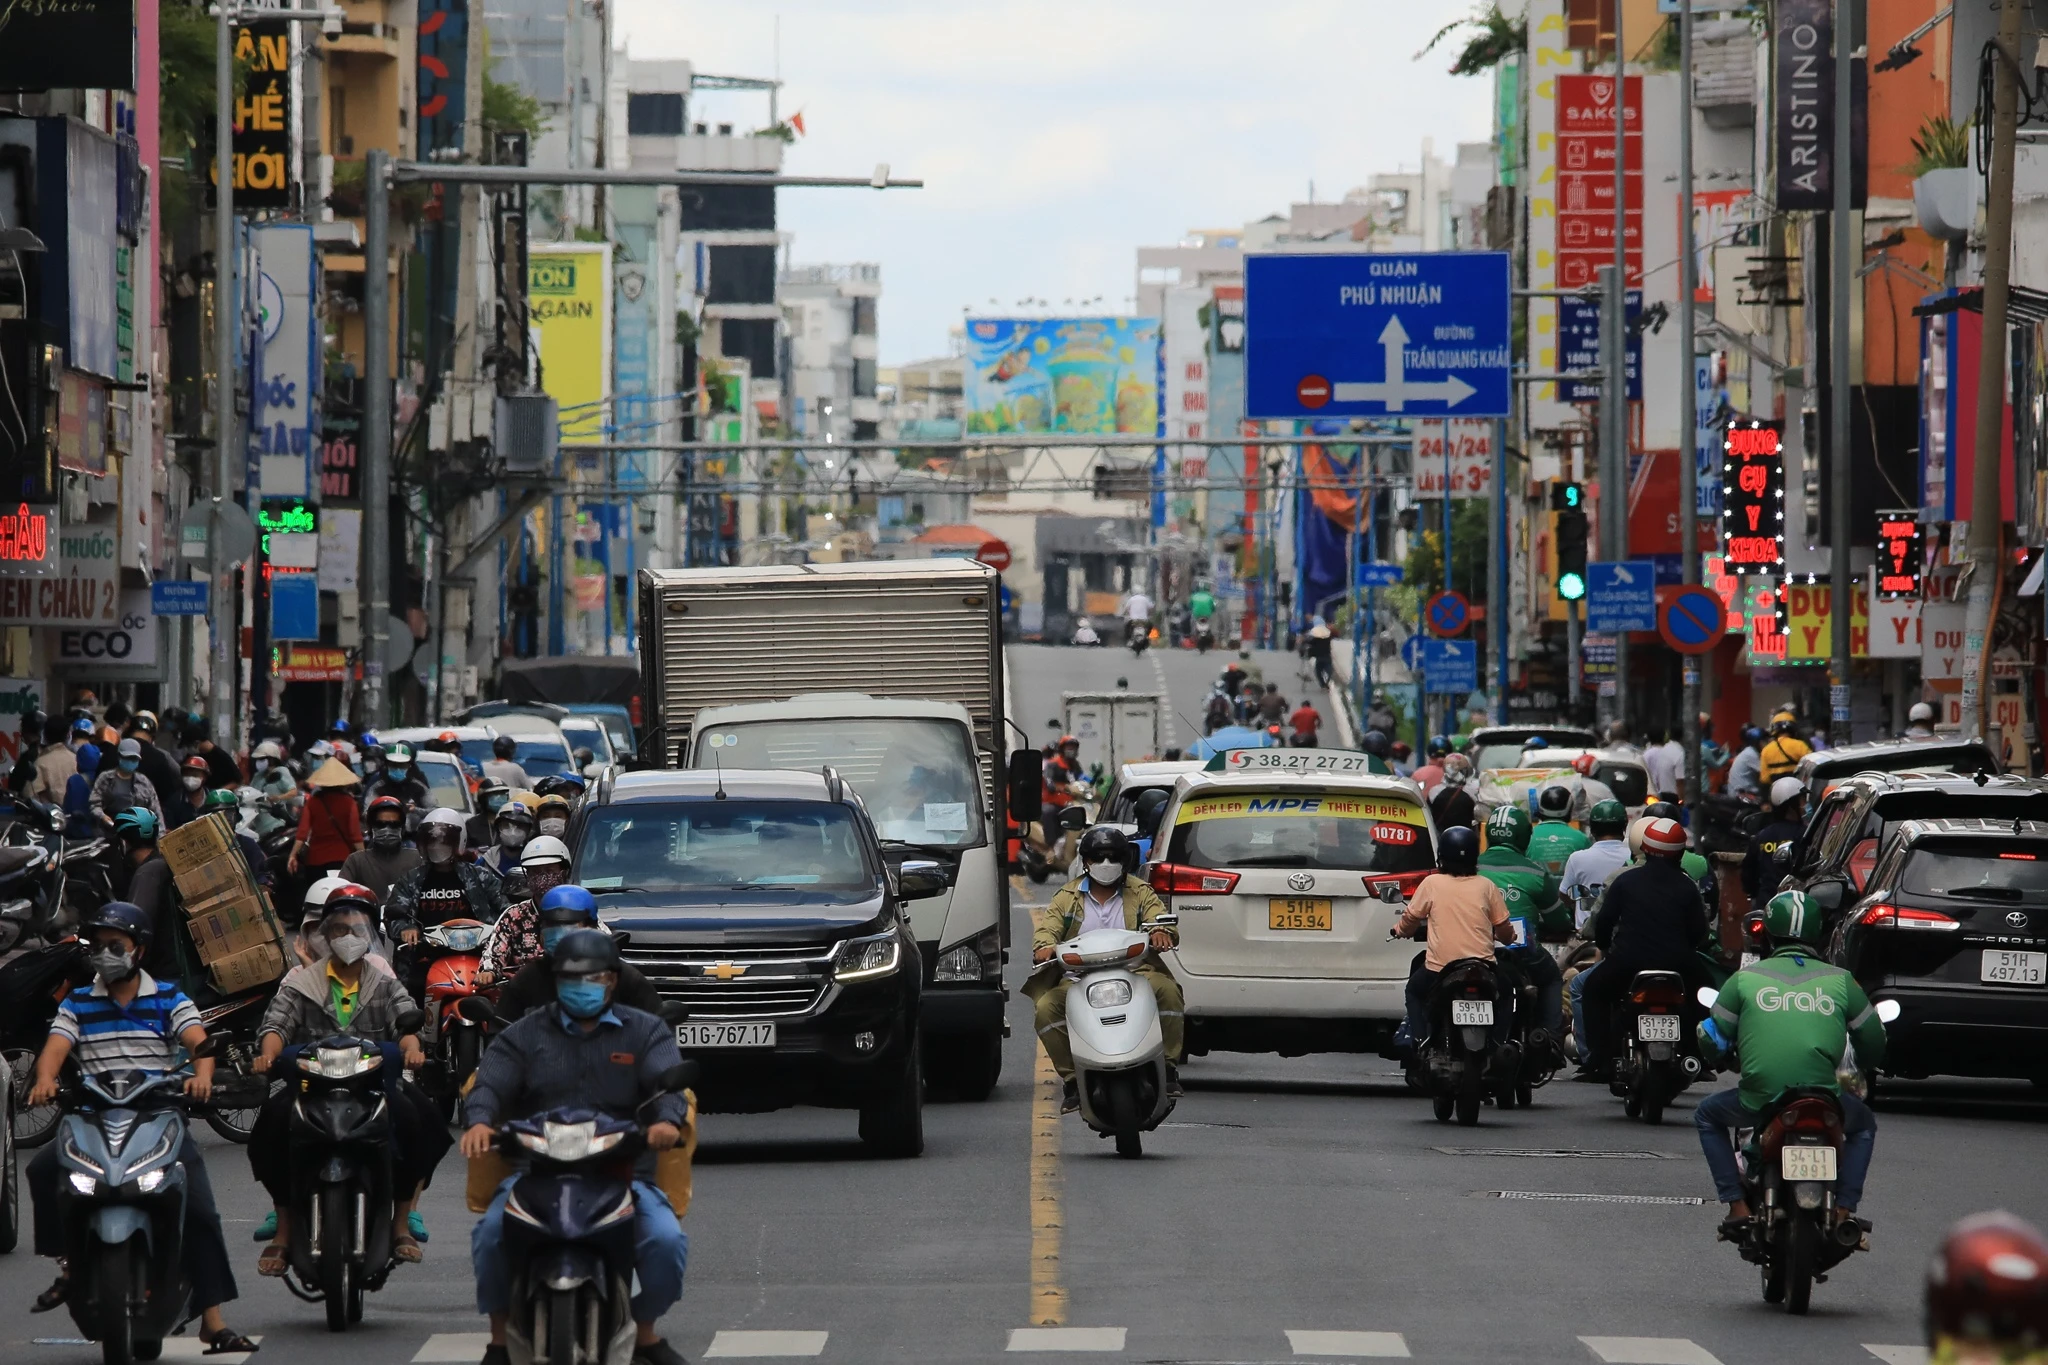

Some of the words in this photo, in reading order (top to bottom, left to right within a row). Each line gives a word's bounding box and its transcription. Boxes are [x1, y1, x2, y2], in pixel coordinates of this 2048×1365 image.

[1792, 24, 1818, 192] ARISTINO
[1369, 262, 1418, 278] QUẬN
[1340, 281, 1375, 306] PHÚ
[1381, 286, 1442, 307] NHUẬN
[1437, 349, 1478, 369] QUANG
[1727, 429, 1779, 462] DỤNG
[1739, 465, 1767, 498] CỤ
[1566, 486, 1578, 506] 9
[1745, 505, 1761, 531] Y
[0, 502, 46, 562] HÂU
[1728, 536, 1779, 563] KHOA
[39, 565, 96, 620] CHÂU
[103, 580, 115, 619] 2
[61, 631, 132, 659] ECO
[1259, 754, 1310, 768] 38.27
[1316, 755, 1338, 769] 27
[1342, 757, 1364, 771] 27
[1193, 801, 1217, 816] ĐÈN
[1220, 802, 1242, 814] LED
[1247, 798, 1324, 814] MPE
[1327, 799, 1361, 815] THIẾT
[1364, 805, 1377, 817] BỊ
[1380, 805, 1408, 818] ĐIỆN
[1373, 826, 1413, 842] 10781
[1490, 828, 1513, 837] Grab
[1286, 901, 1314, 914] 51H
[1276, 915, 1325, 928] 215.94
[1986, 936, 2047, 945] CROSS
[2001, 953, 2028, 967] 51H
[1989, 967, 2039, 981] 497.13
[1459, 1002, 1486, 1013] 59-V1
[1756, 986, 1835, 1016] Grab
[1455, 1013, 1490, 1024] 816.01
[1644, 1018, 1673, 1028] 51-P3
[678, 1023, 772, 1046] 51G-767.17
[1645, 1028, 1674, 1038] 9758
